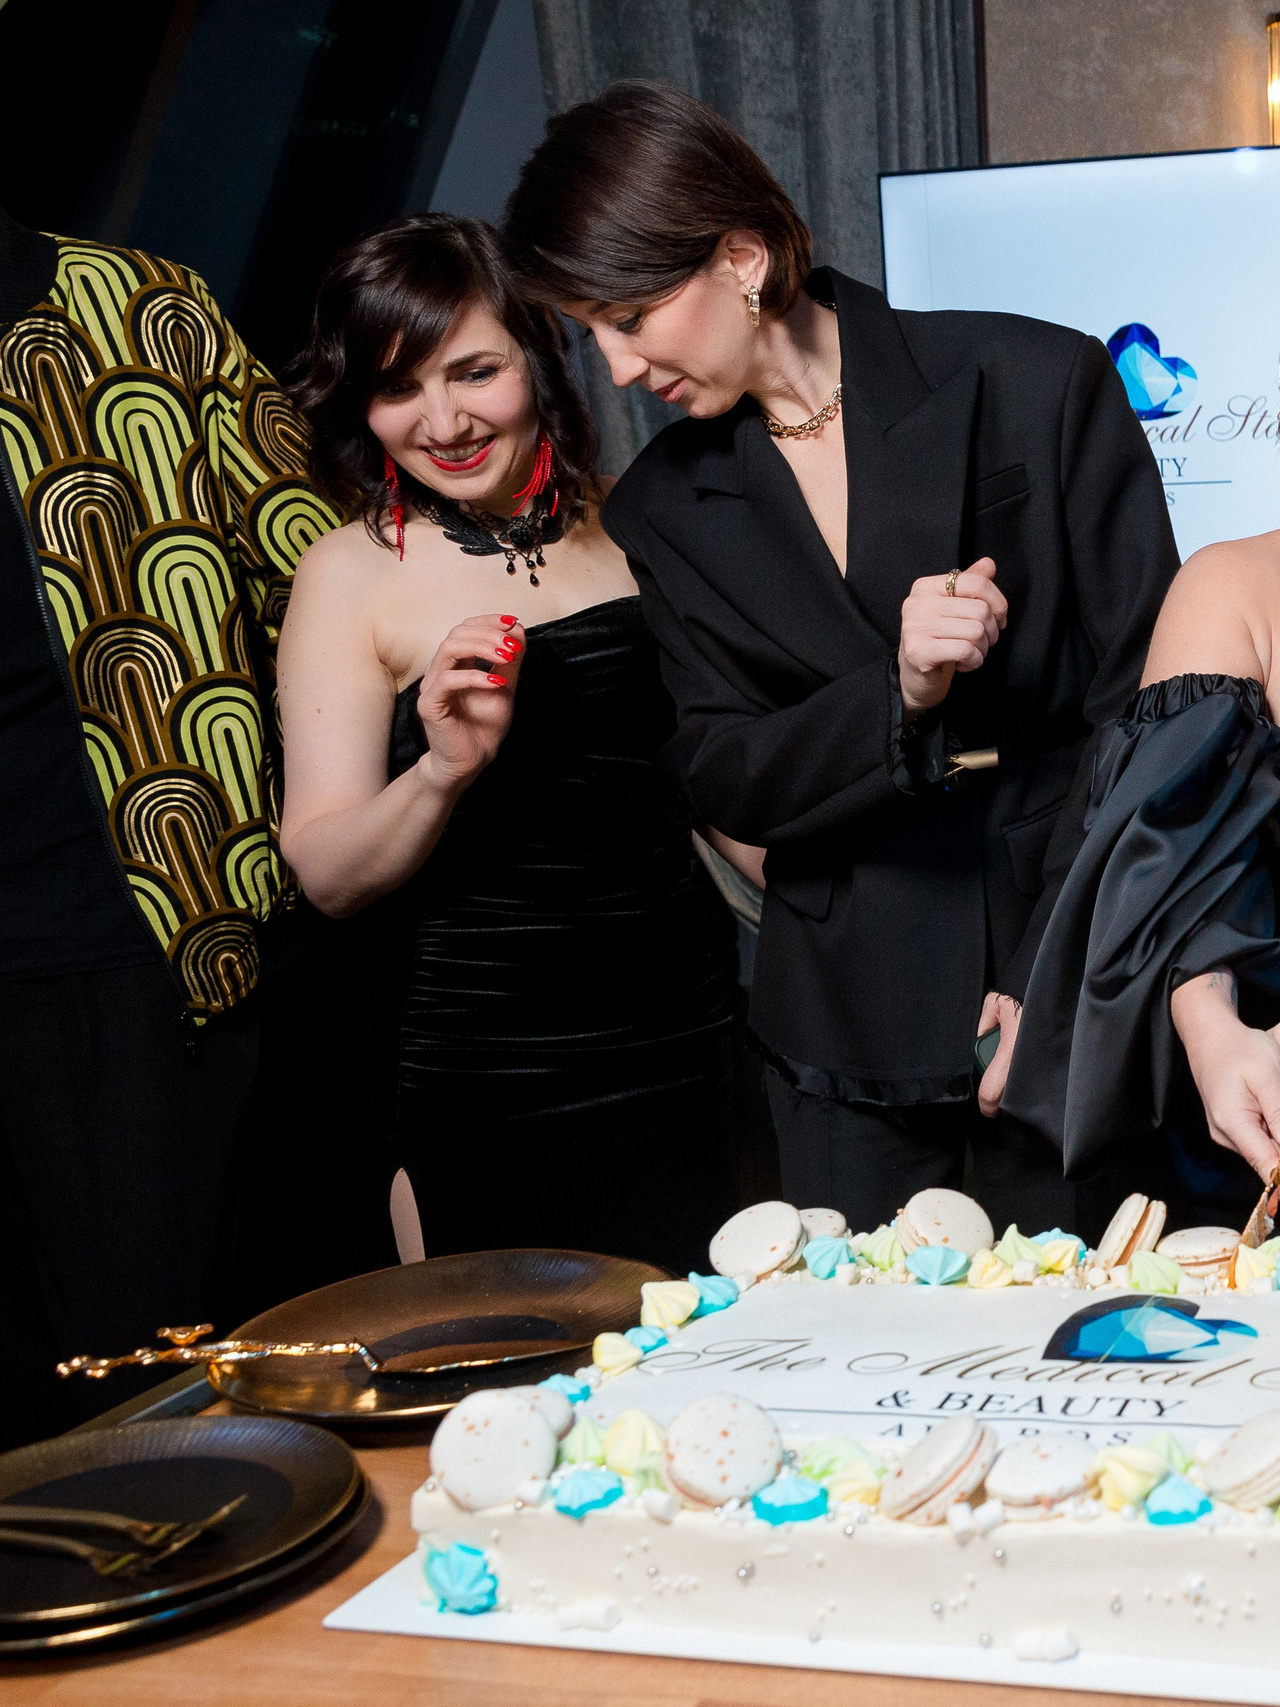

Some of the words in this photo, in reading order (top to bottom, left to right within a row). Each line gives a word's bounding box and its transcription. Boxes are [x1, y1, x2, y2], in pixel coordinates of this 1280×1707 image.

[1207, 394, 1279, 442] Sta
[636, 1337, 827, 1375] The
[847, 1344, 1254, 1387] Medical
[875, 1389, 914, 1410] &
[930, 1390, 1188, 1419] BEAUTY
